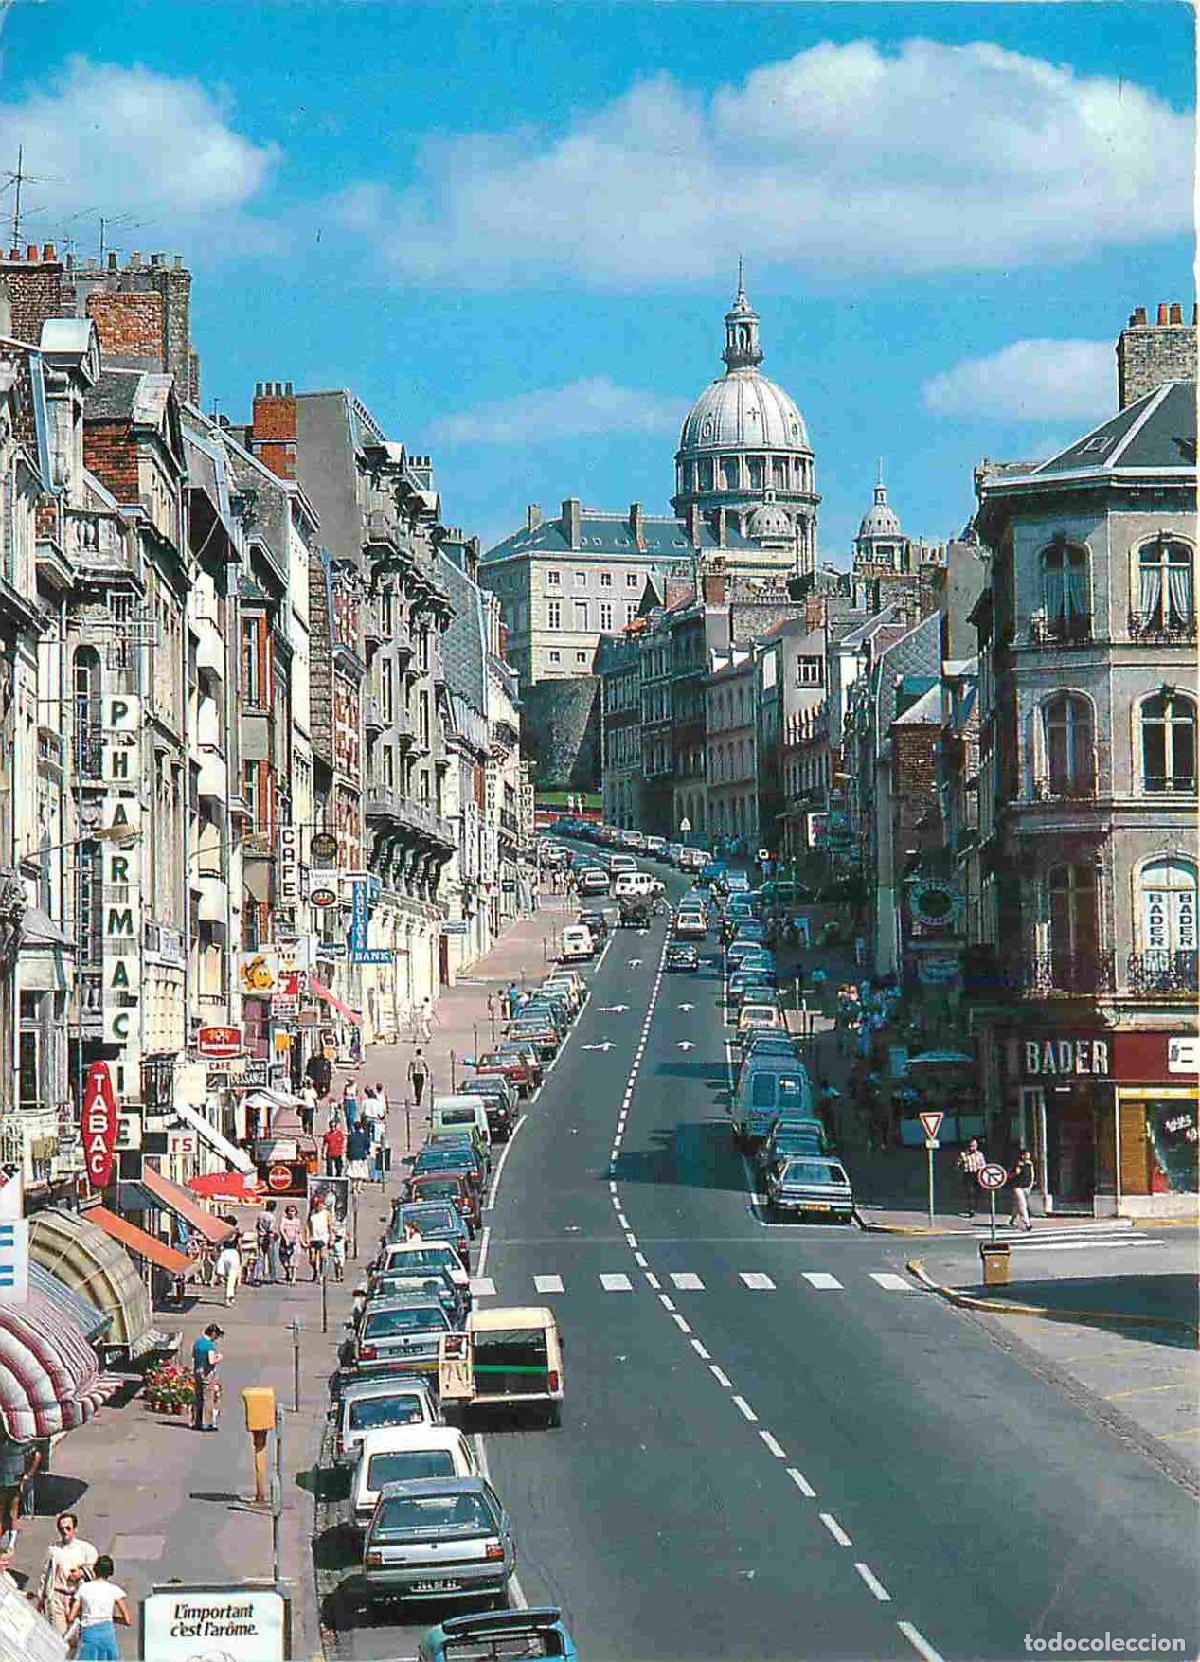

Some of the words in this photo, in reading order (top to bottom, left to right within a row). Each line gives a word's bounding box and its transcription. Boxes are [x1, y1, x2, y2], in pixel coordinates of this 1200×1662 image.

[282, 829, 296, 898] CAFE
[107, 700, 135, 1147] PHARMACIE
[1149, 893, 1166, 947] BADER
[1179, 893, 1194, 946] BADER
[354, 951, 389, 962] BANK
[1025, 1040, 1109, 1075] BADER
[88, 1073, 109, 1174] TABAC
[170, 1621, 202, 1637] c'est
[174, 1603, 255, 1623] L'important
